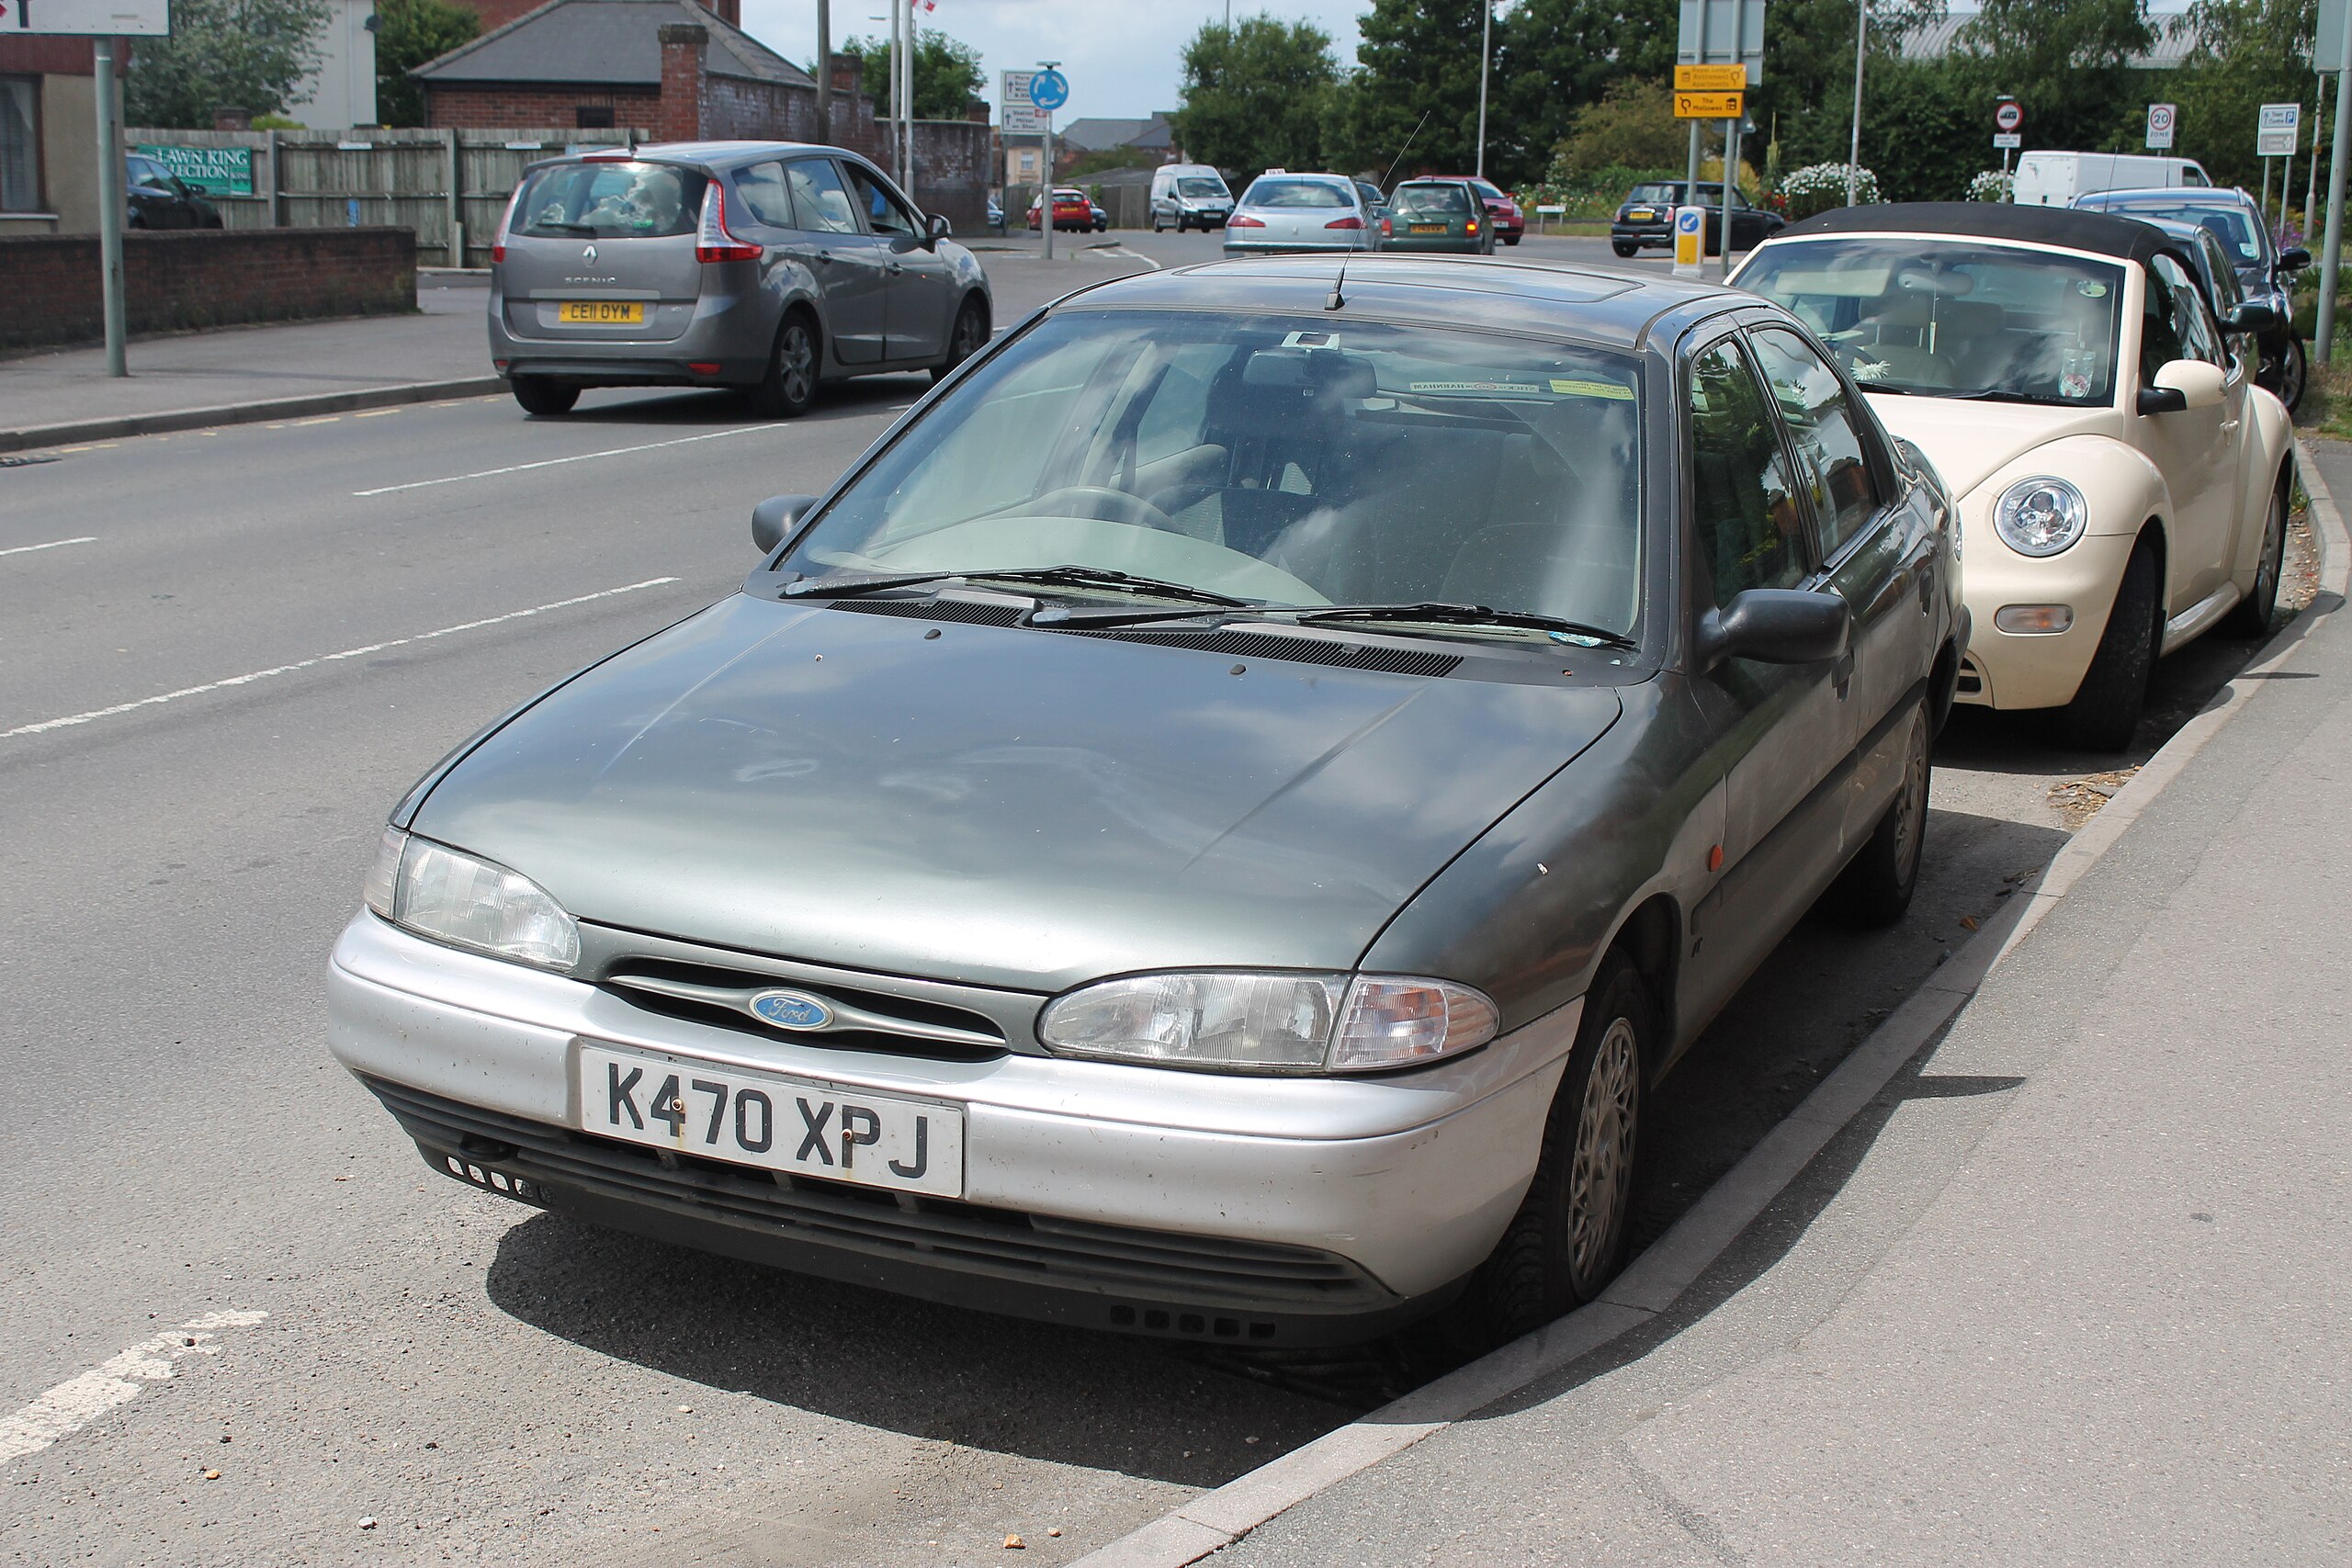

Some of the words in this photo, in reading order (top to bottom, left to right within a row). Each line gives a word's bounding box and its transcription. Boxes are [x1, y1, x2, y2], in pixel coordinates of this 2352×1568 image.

[2154, 113, 2169, 124] 20
[156, 147, 203, 164] LAWN
[207, 149, 248, 165] KING
[571, 304, 597, 319] CE11
[601, 304, 631, 320] OYM
[769, 998, 812, 1021] Ford
[608, 1062, 774, 1154] K470
[796, 1097, 928, 1179] XPJ
